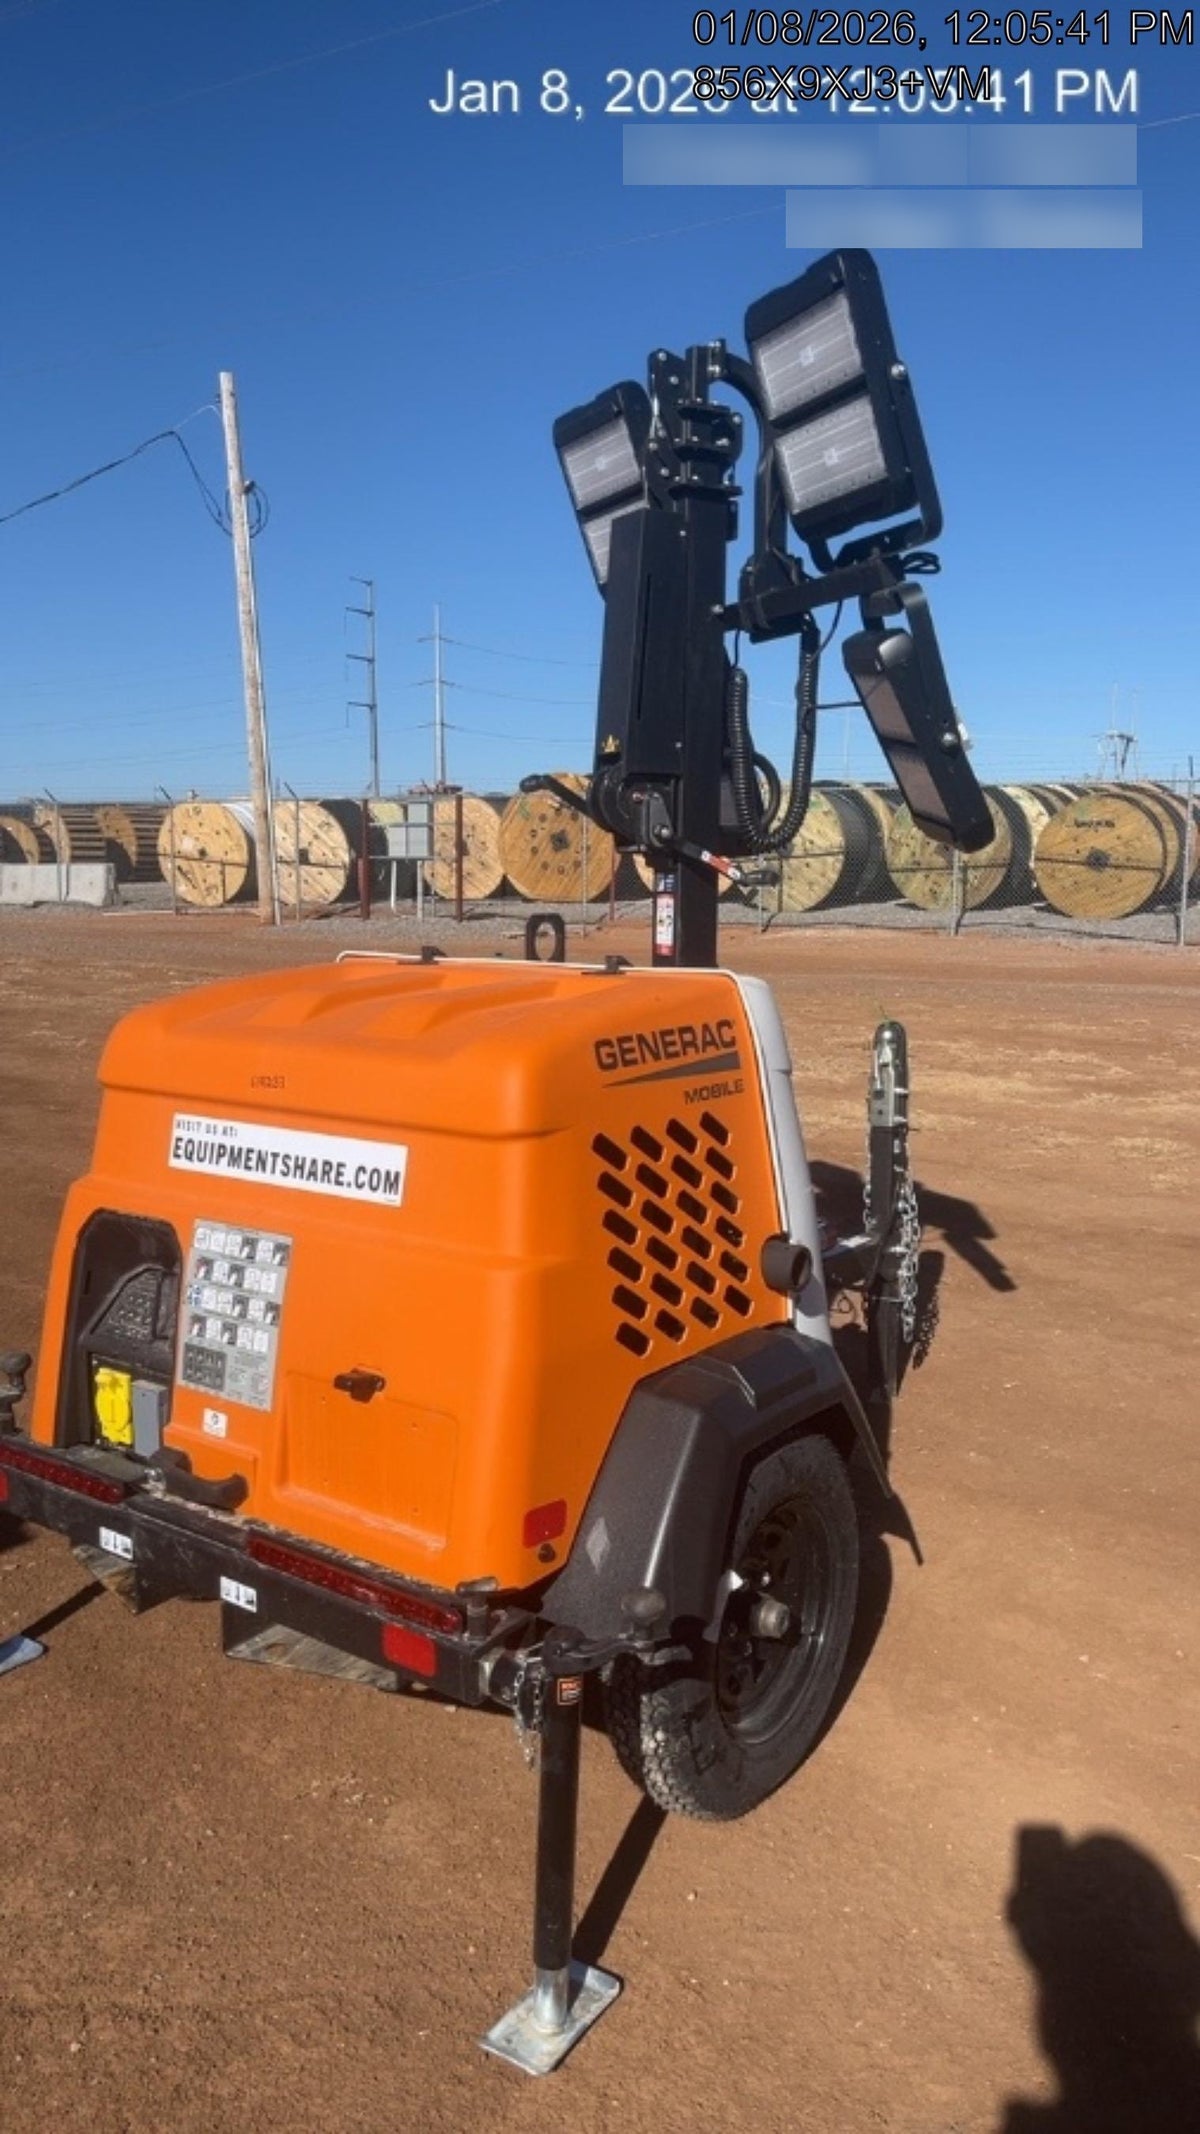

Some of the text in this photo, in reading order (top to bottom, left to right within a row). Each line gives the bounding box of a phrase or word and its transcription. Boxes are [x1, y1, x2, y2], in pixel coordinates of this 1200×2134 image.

[594, 1019, 737, 1072] GENERAC
[684, 1078, 745, 1105] MOBILE
[205, 1123, 218, 1136] US
[172, 1136, 402, 1196] EQUIPMENTSHARE.COM
